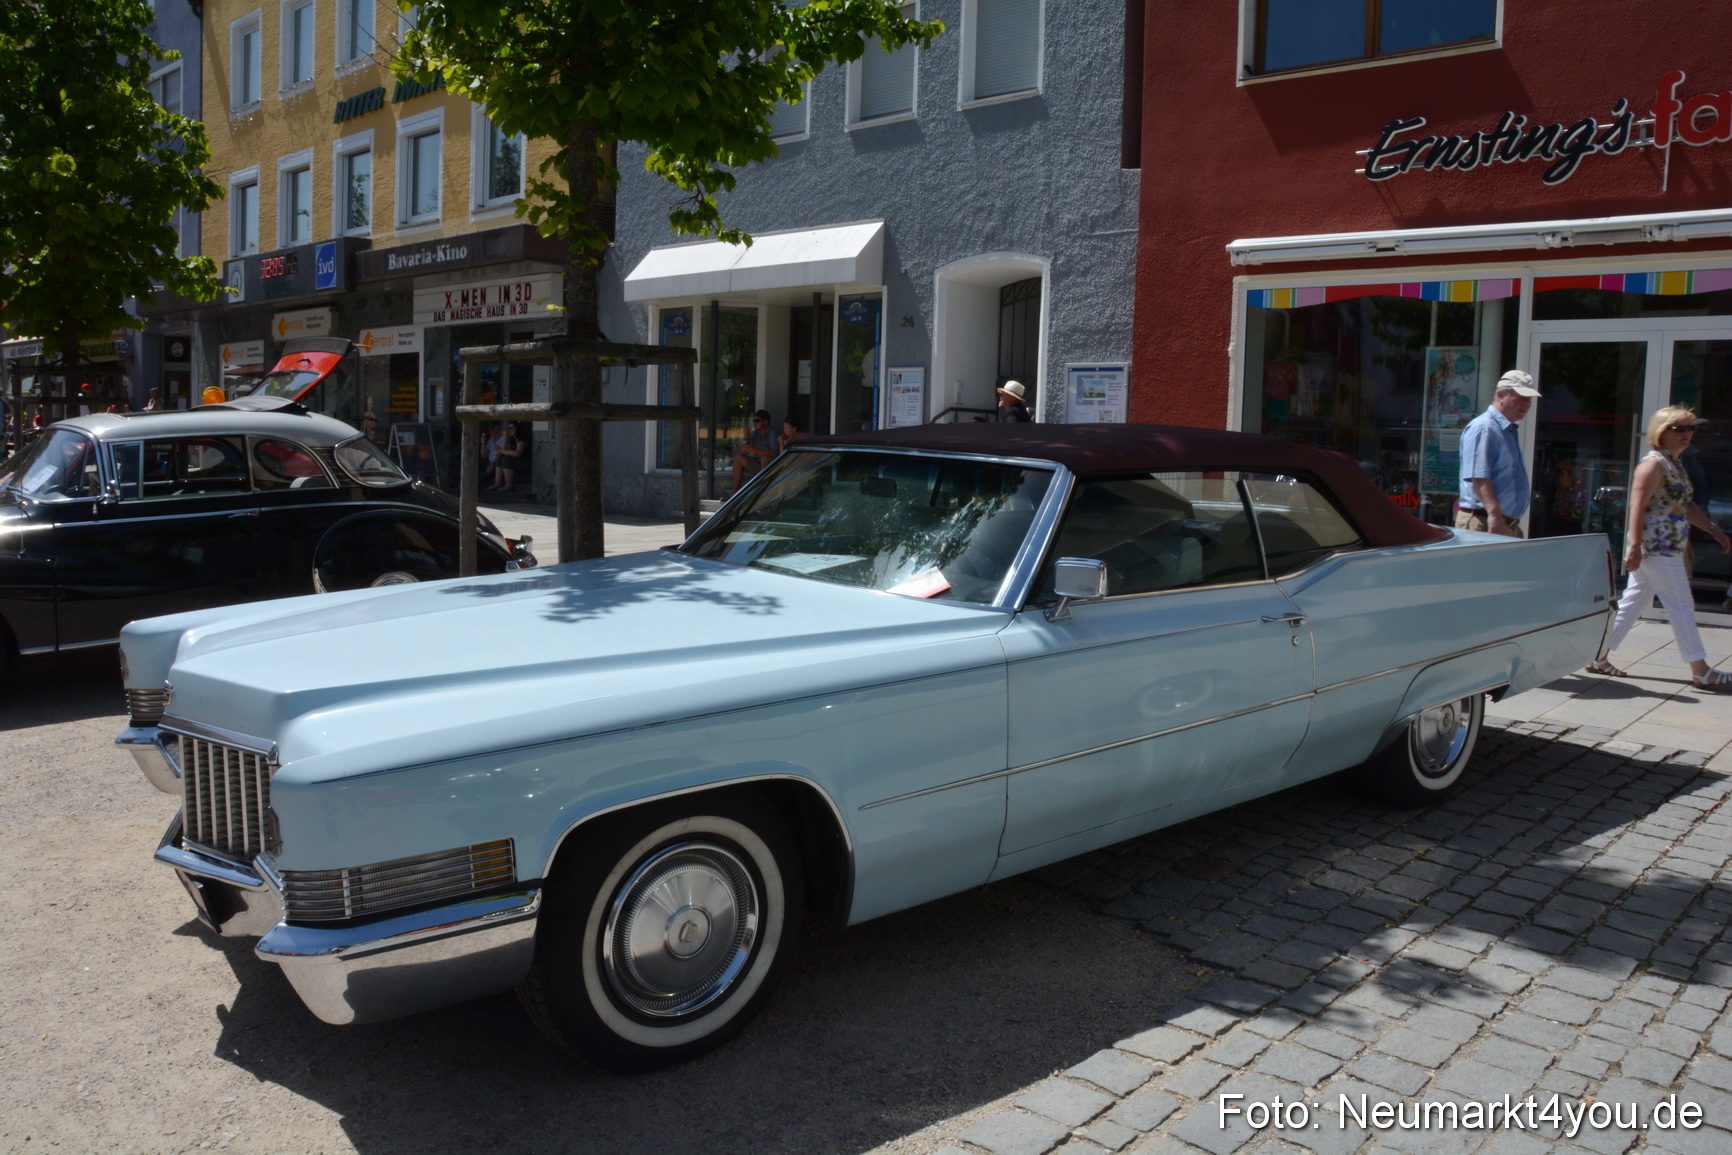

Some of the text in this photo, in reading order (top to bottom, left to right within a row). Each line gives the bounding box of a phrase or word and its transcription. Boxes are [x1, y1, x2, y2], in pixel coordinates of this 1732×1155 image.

[333, 86, 386, 124] RITTER
[1364, 98, 1635, 185] Ernsting's
[318, 256, 334, 275] ivd
[388, 244, 468, 270] Bavaria-Kino
[498, 285, 511, 304] IN
[515, 282, 532, 302] 3D
[433, 311, 446, 323] DAS
[450, 307, 483, 321] MAGISCHE
[486, 305, 505, 318] HAUS
[509, 304, 517, 316] IN
